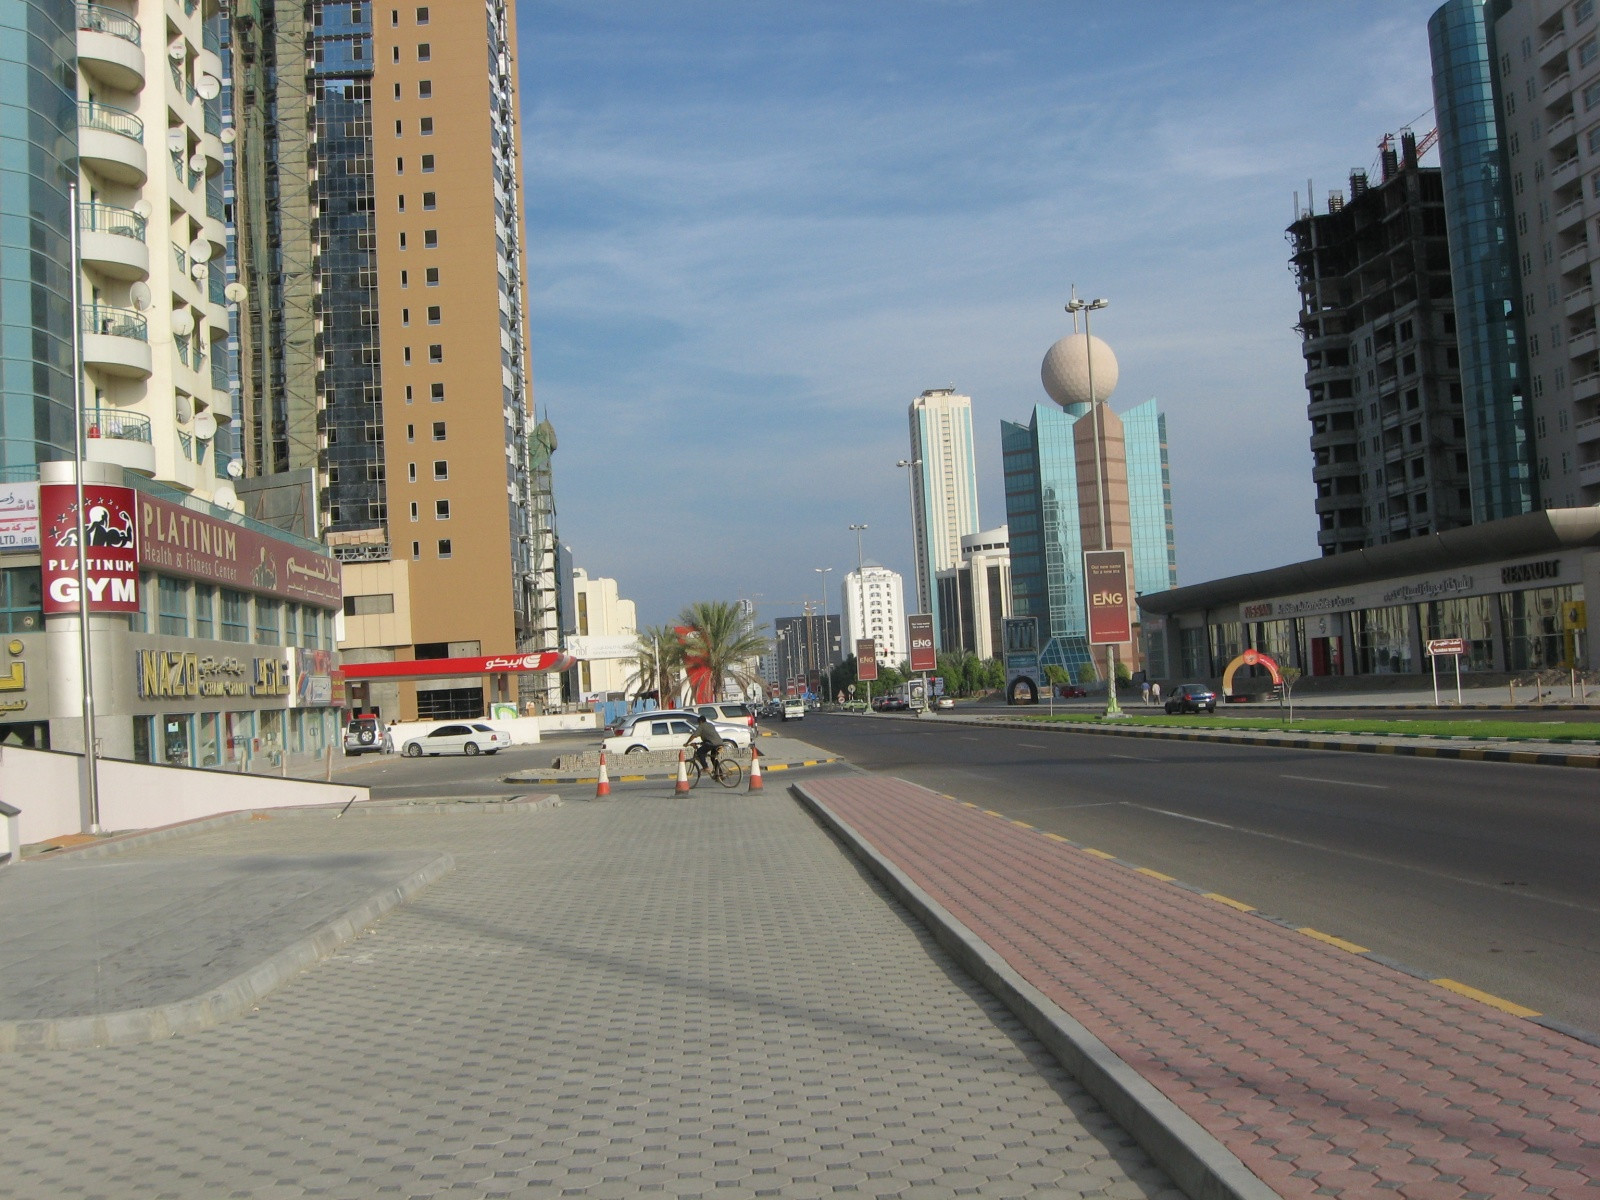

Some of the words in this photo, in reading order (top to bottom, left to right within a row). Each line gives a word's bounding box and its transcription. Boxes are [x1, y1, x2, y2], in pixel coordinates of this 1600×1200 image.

[143, 501, 236, 561] PLATINUM
[48, 559, 134, 572] PLATINUM
[144, 540, 173, 566] Health
[186, 551, 212, 576] Fitness
[214, 559, 237, 580] Center
[1501, 559, 1560, 584] RENAULT
[49, 577, 136, 603] GYM
[1093, 593, 1123, 605] ENG
[912, 639, 931, 648] ENG
[859, 656, 874, 664] ENG
[137, 650, 199, 698] NAZO
